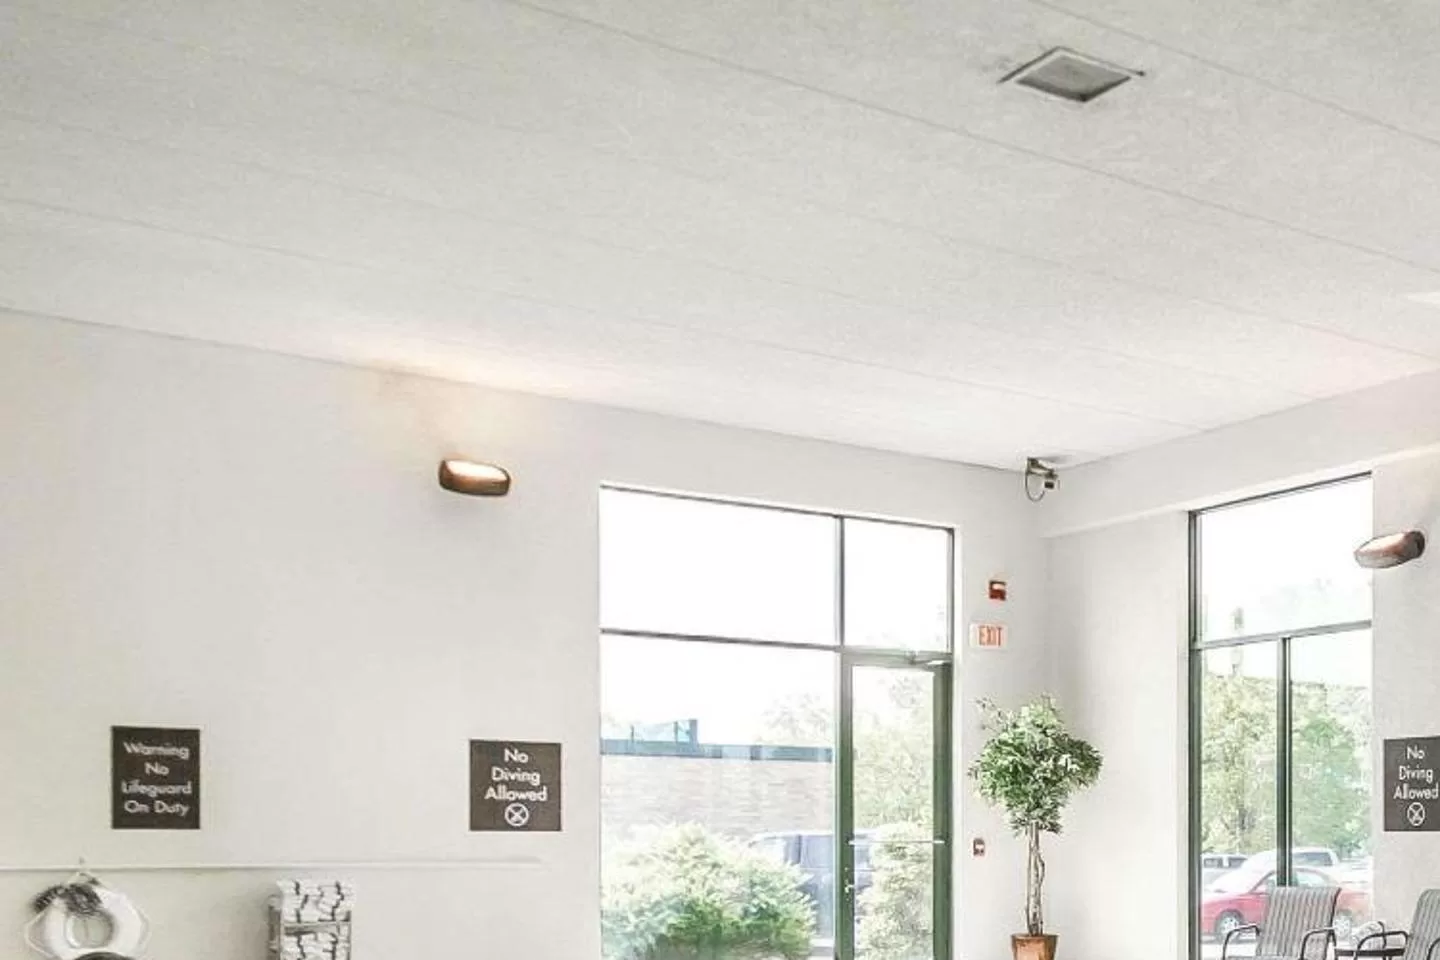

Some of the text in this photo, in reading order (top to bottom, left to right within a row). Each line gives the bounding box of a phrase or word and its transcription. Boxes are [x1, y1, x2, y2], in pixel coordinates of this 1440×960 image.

[123, 742, 190, 760] Warning
[504, 748, 529, 763] No
[1406, 744, 1425, 760] No
[144, 762, 170, 776] No
[491, 766, 541, 786] Diving
[1399, 763, 1433, 784] Diving
[484, 784, 548, 802] Allowed
[1393, 782, 1439, 800] Allowed
[124, 800, 190, 817] On Duty
